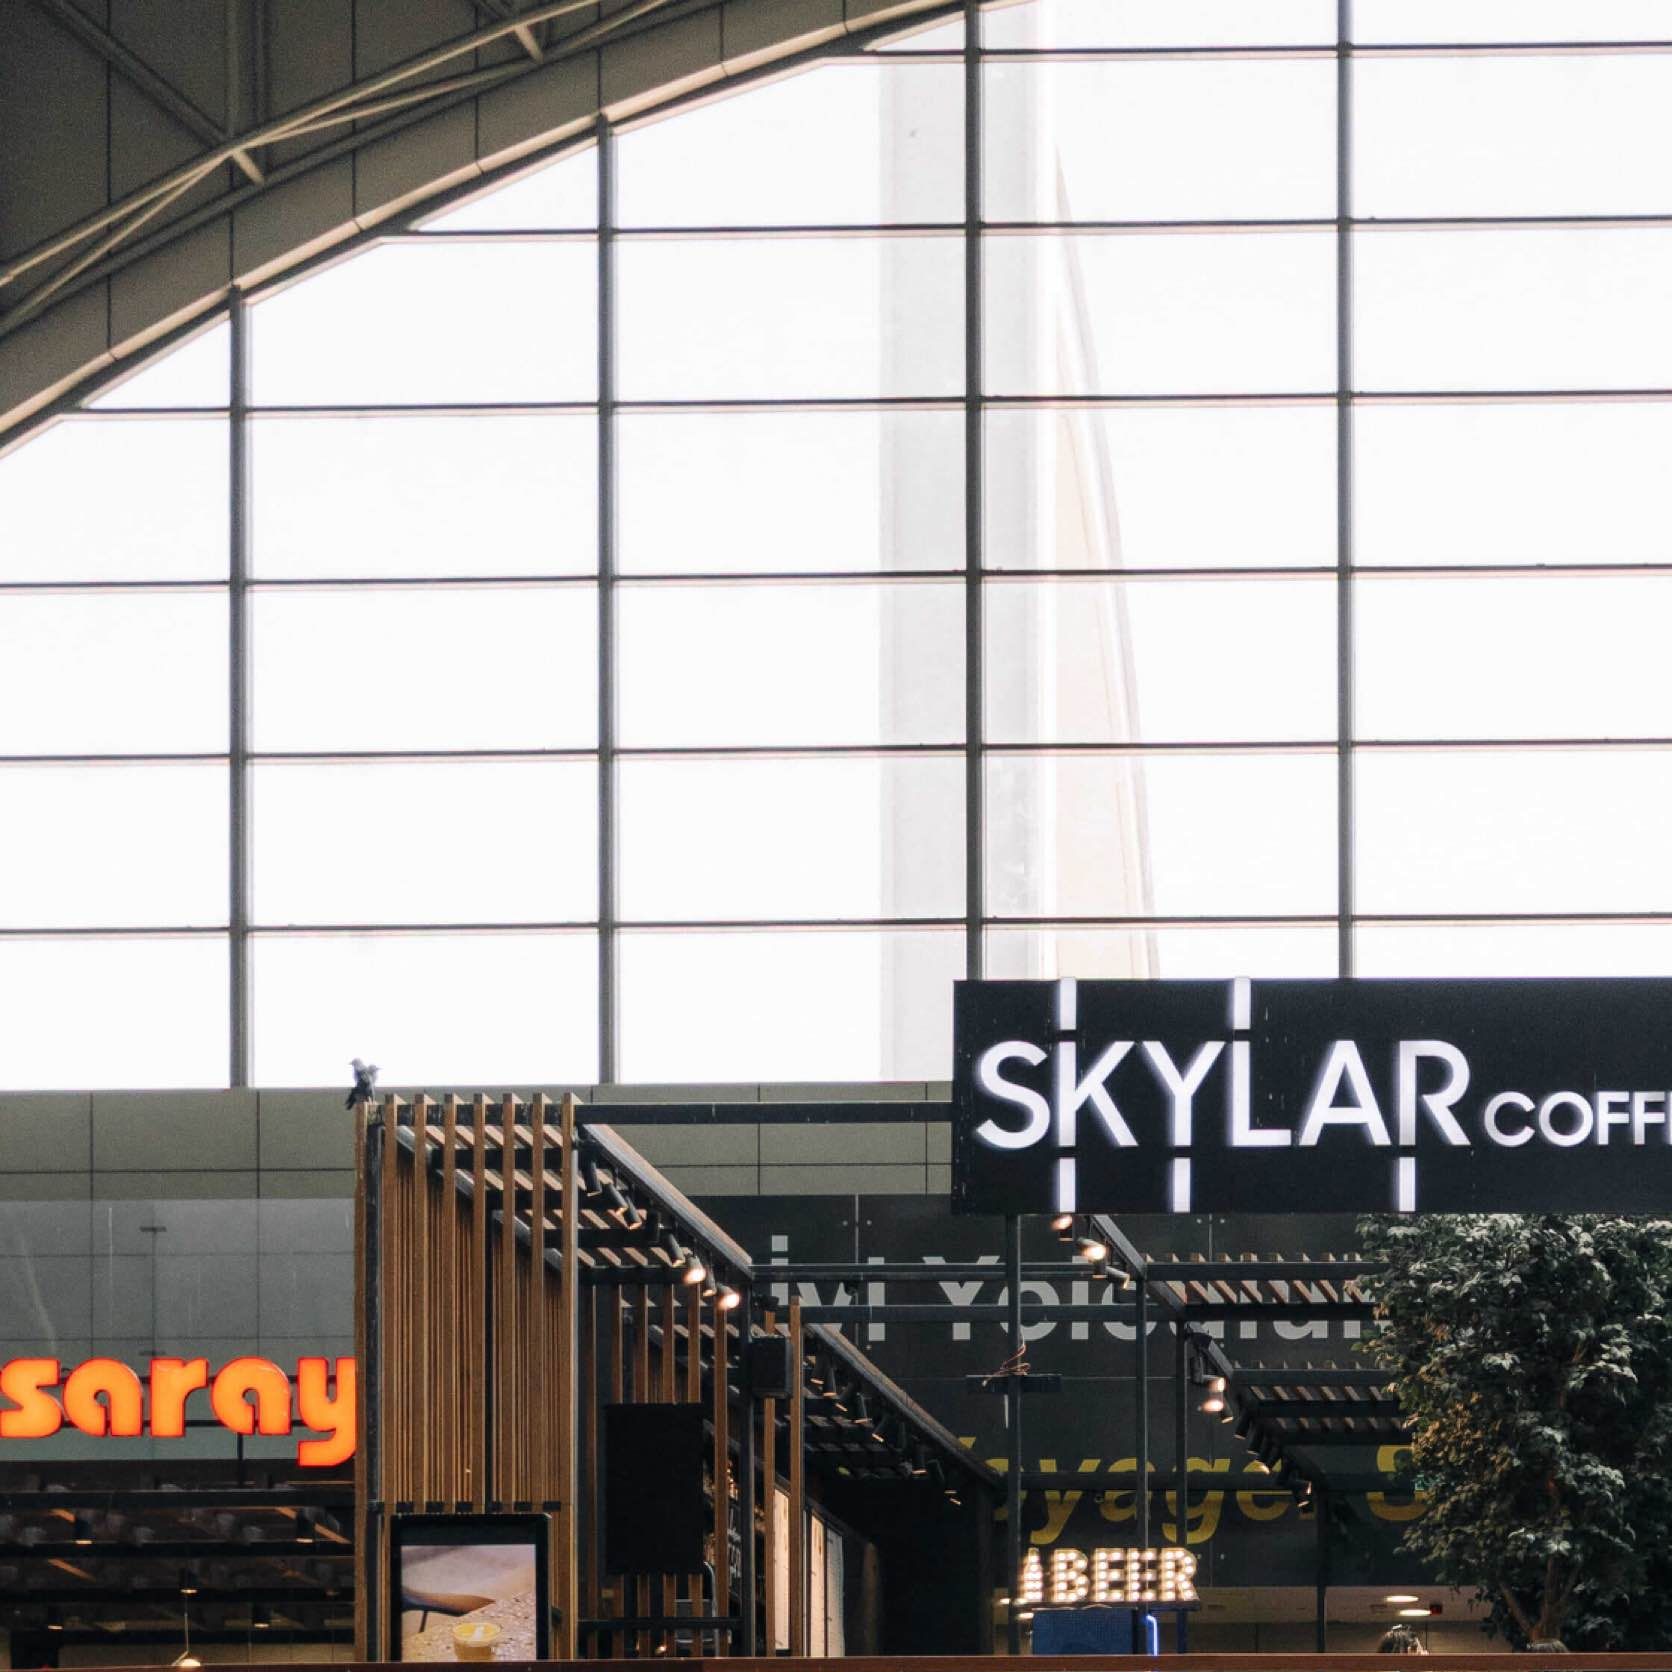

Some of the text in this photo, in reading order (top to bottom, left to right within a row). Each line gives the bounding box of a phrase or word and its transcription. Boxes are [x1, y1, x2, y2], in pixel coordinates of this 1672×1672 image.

[975, 1038, 1472, 1150] SKYLAR
[0, 1355, 357, 1467] saray
[1052, 1547, 1198, 1602] BEER
